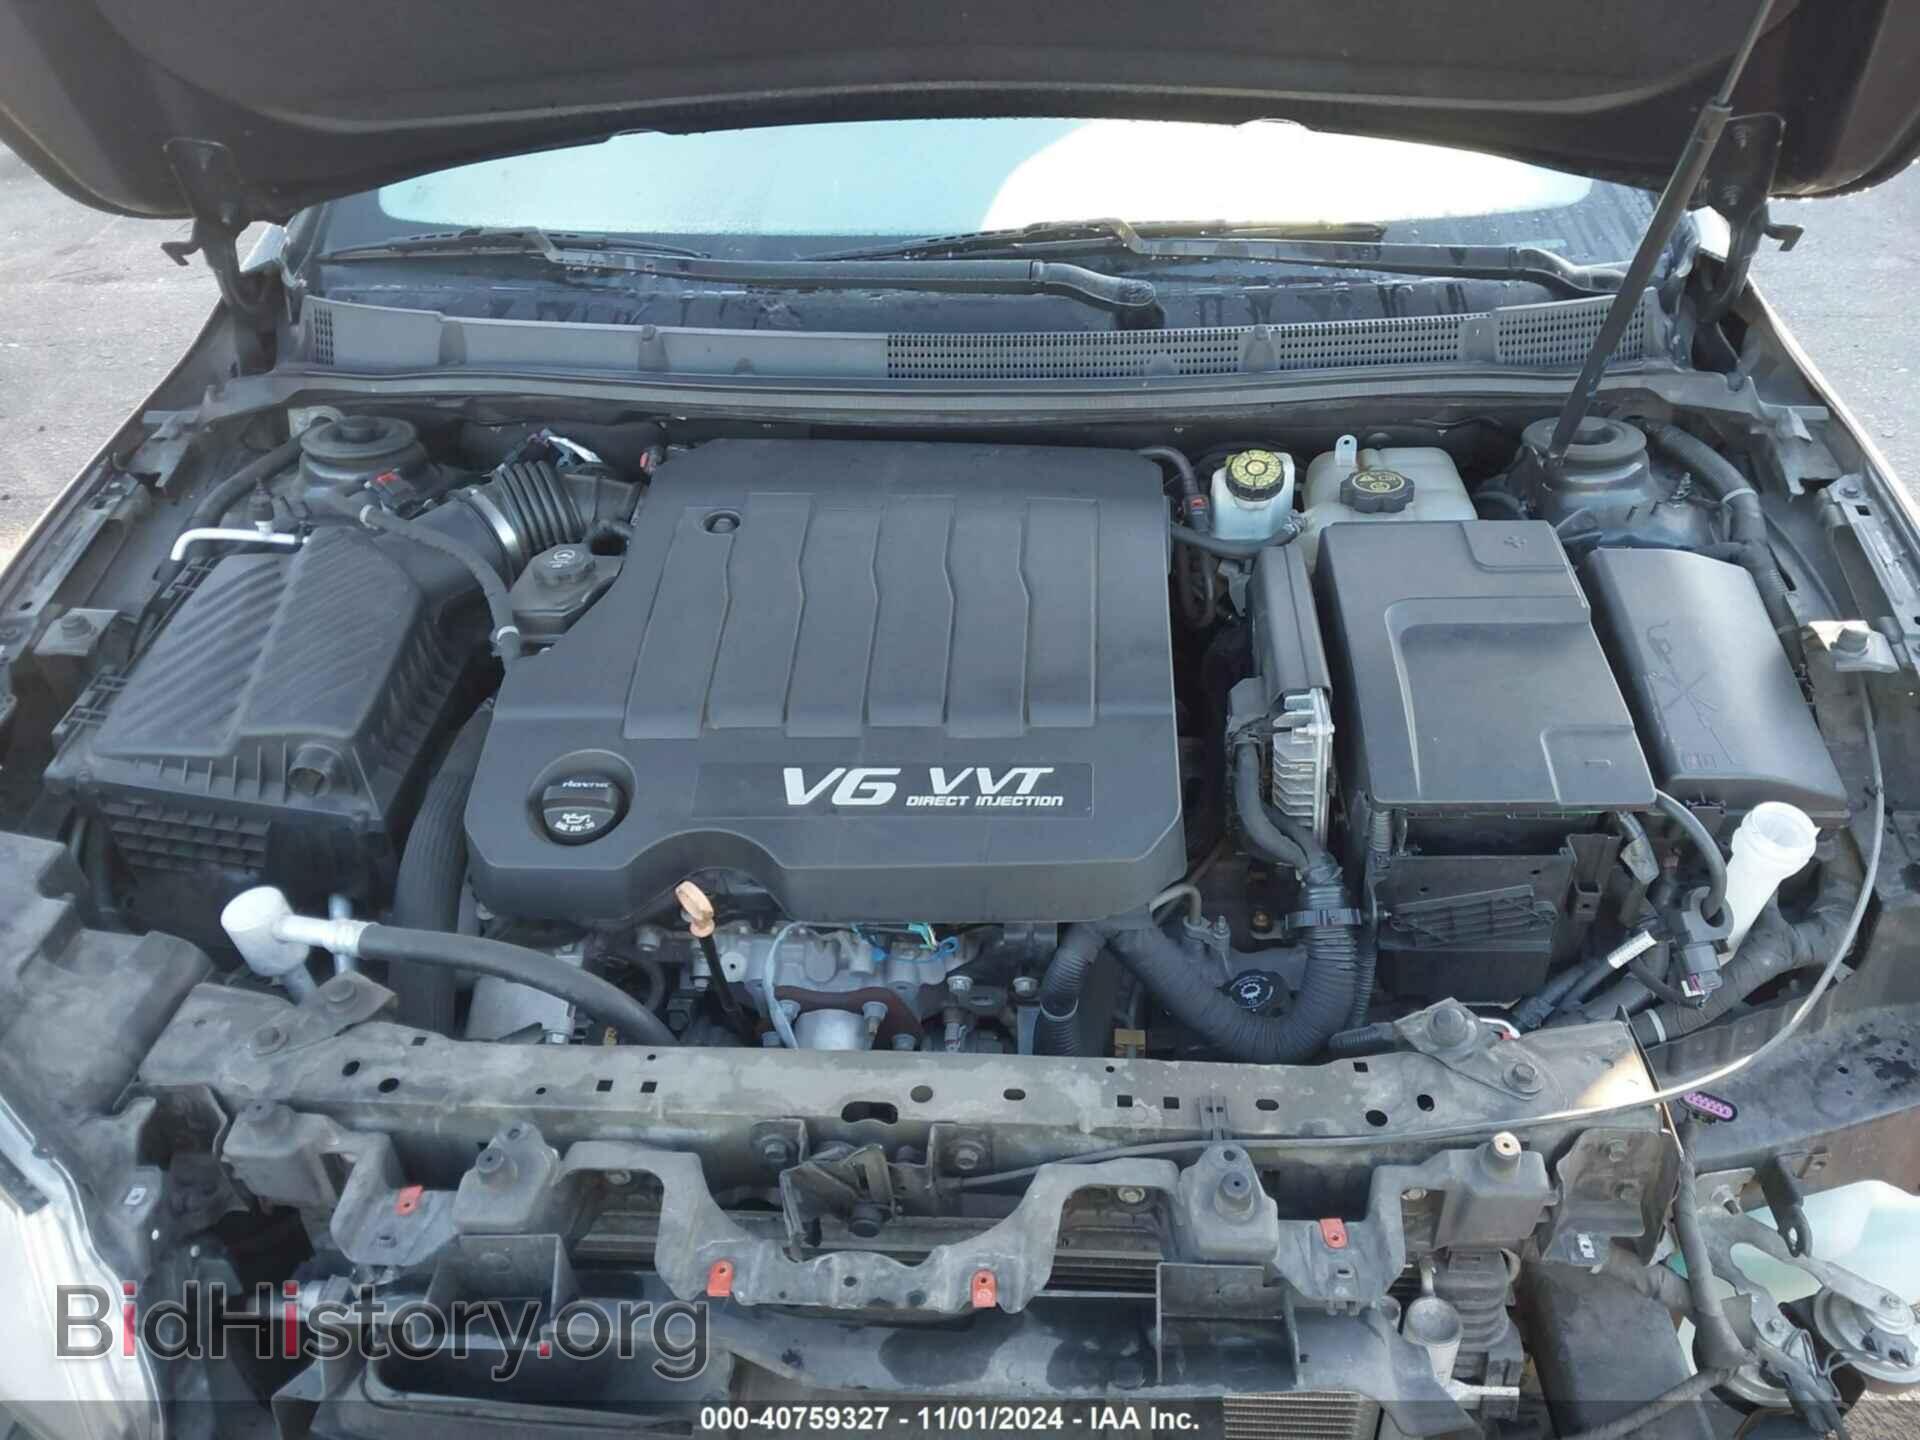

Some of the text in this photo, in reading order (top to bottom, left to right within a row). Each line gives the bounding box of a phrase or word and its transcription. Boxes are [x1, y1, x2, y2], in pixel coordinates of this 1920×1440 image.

[782, 766, 1054, 805] V6 VVT
[905, 795, 1063, 806] DIRECT INJECTION
